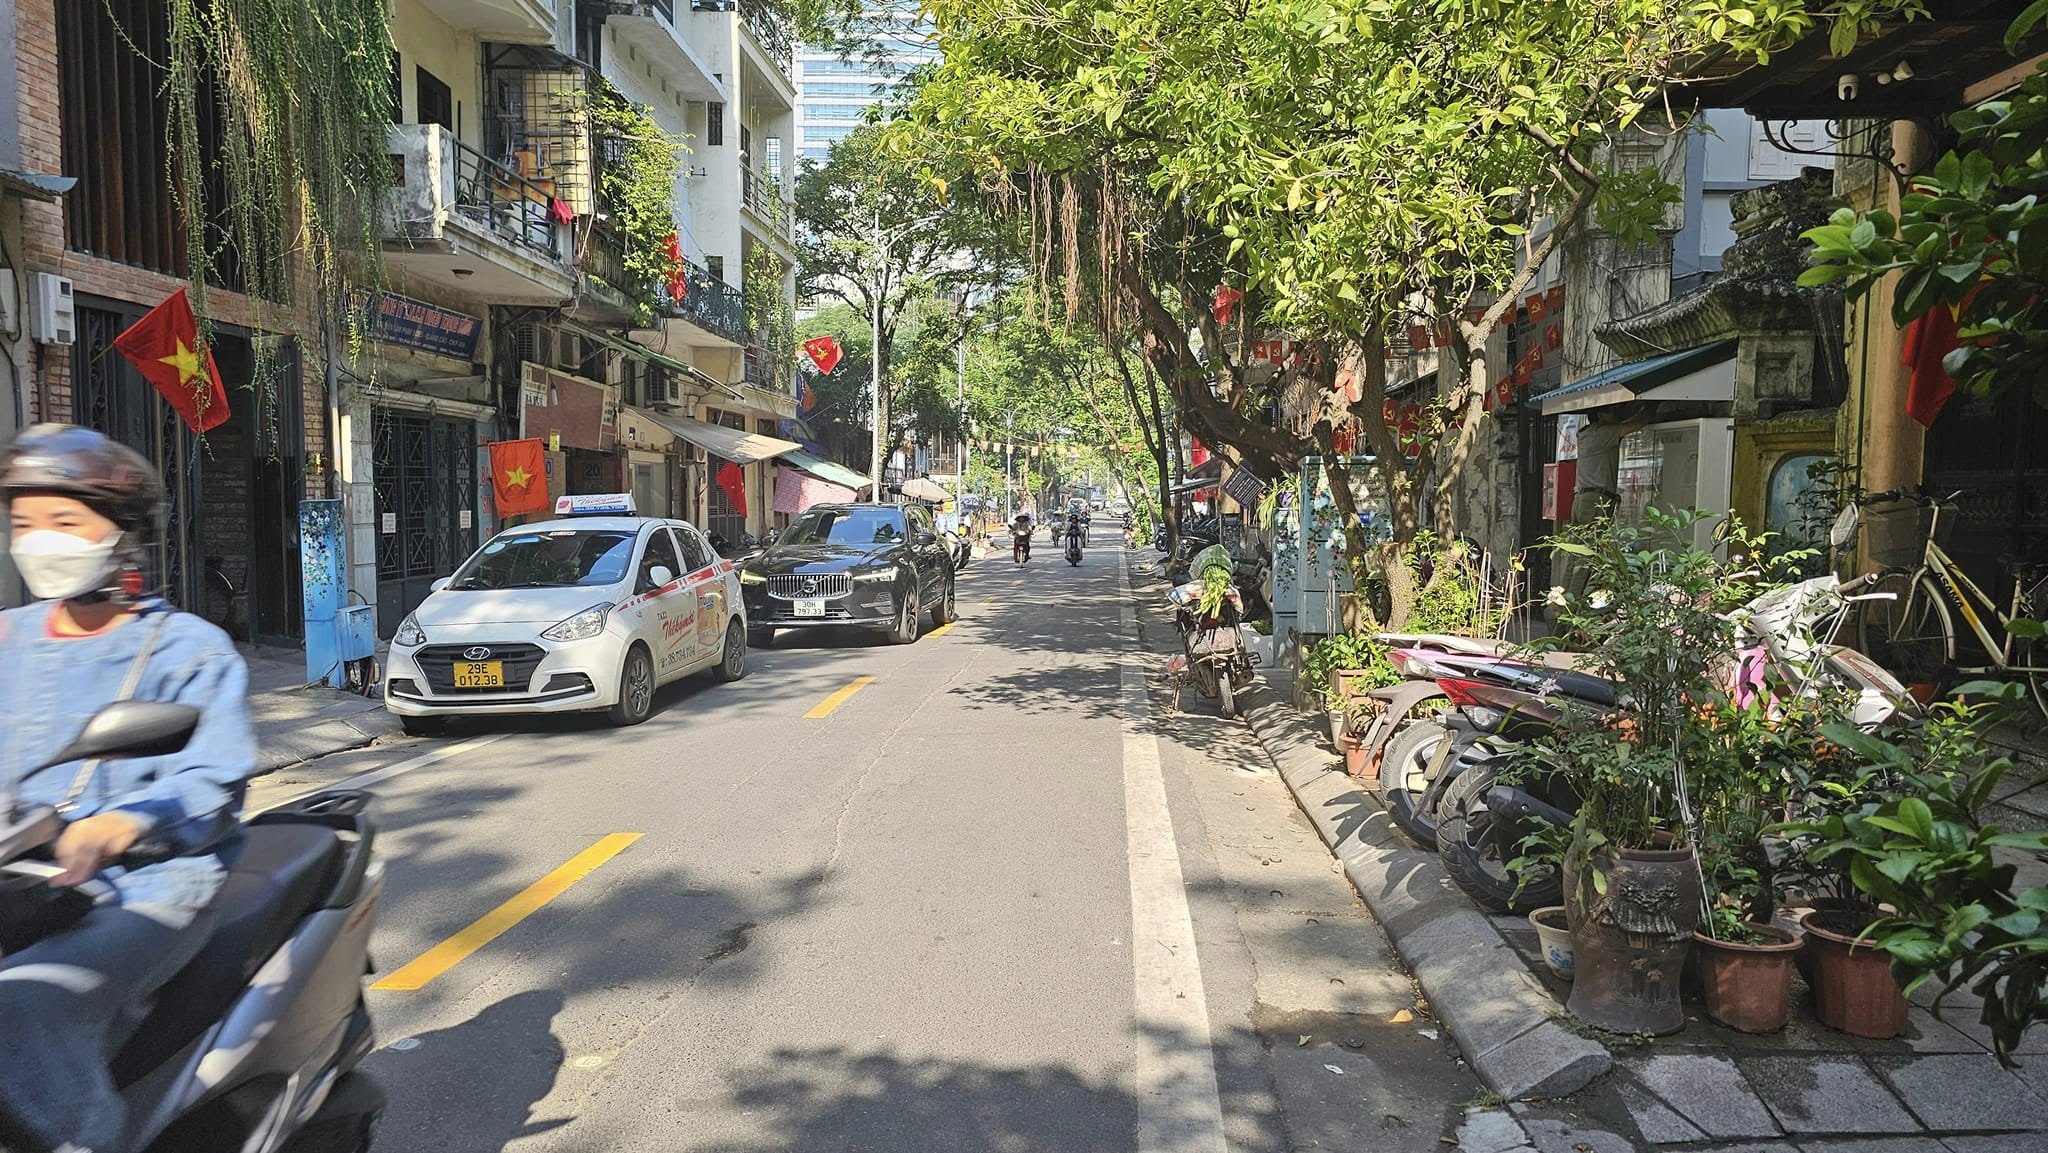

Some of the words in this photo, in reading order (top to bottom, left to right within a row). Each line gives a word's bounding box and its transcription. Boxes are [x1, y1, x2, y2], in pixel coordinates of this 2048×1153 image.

[585, 463, 600, 477] 20
[1935, 572, 1965, 608] ASAMA
[467, 663, 488, 674] 29E
[459, 674, 498, 686] 012.38
